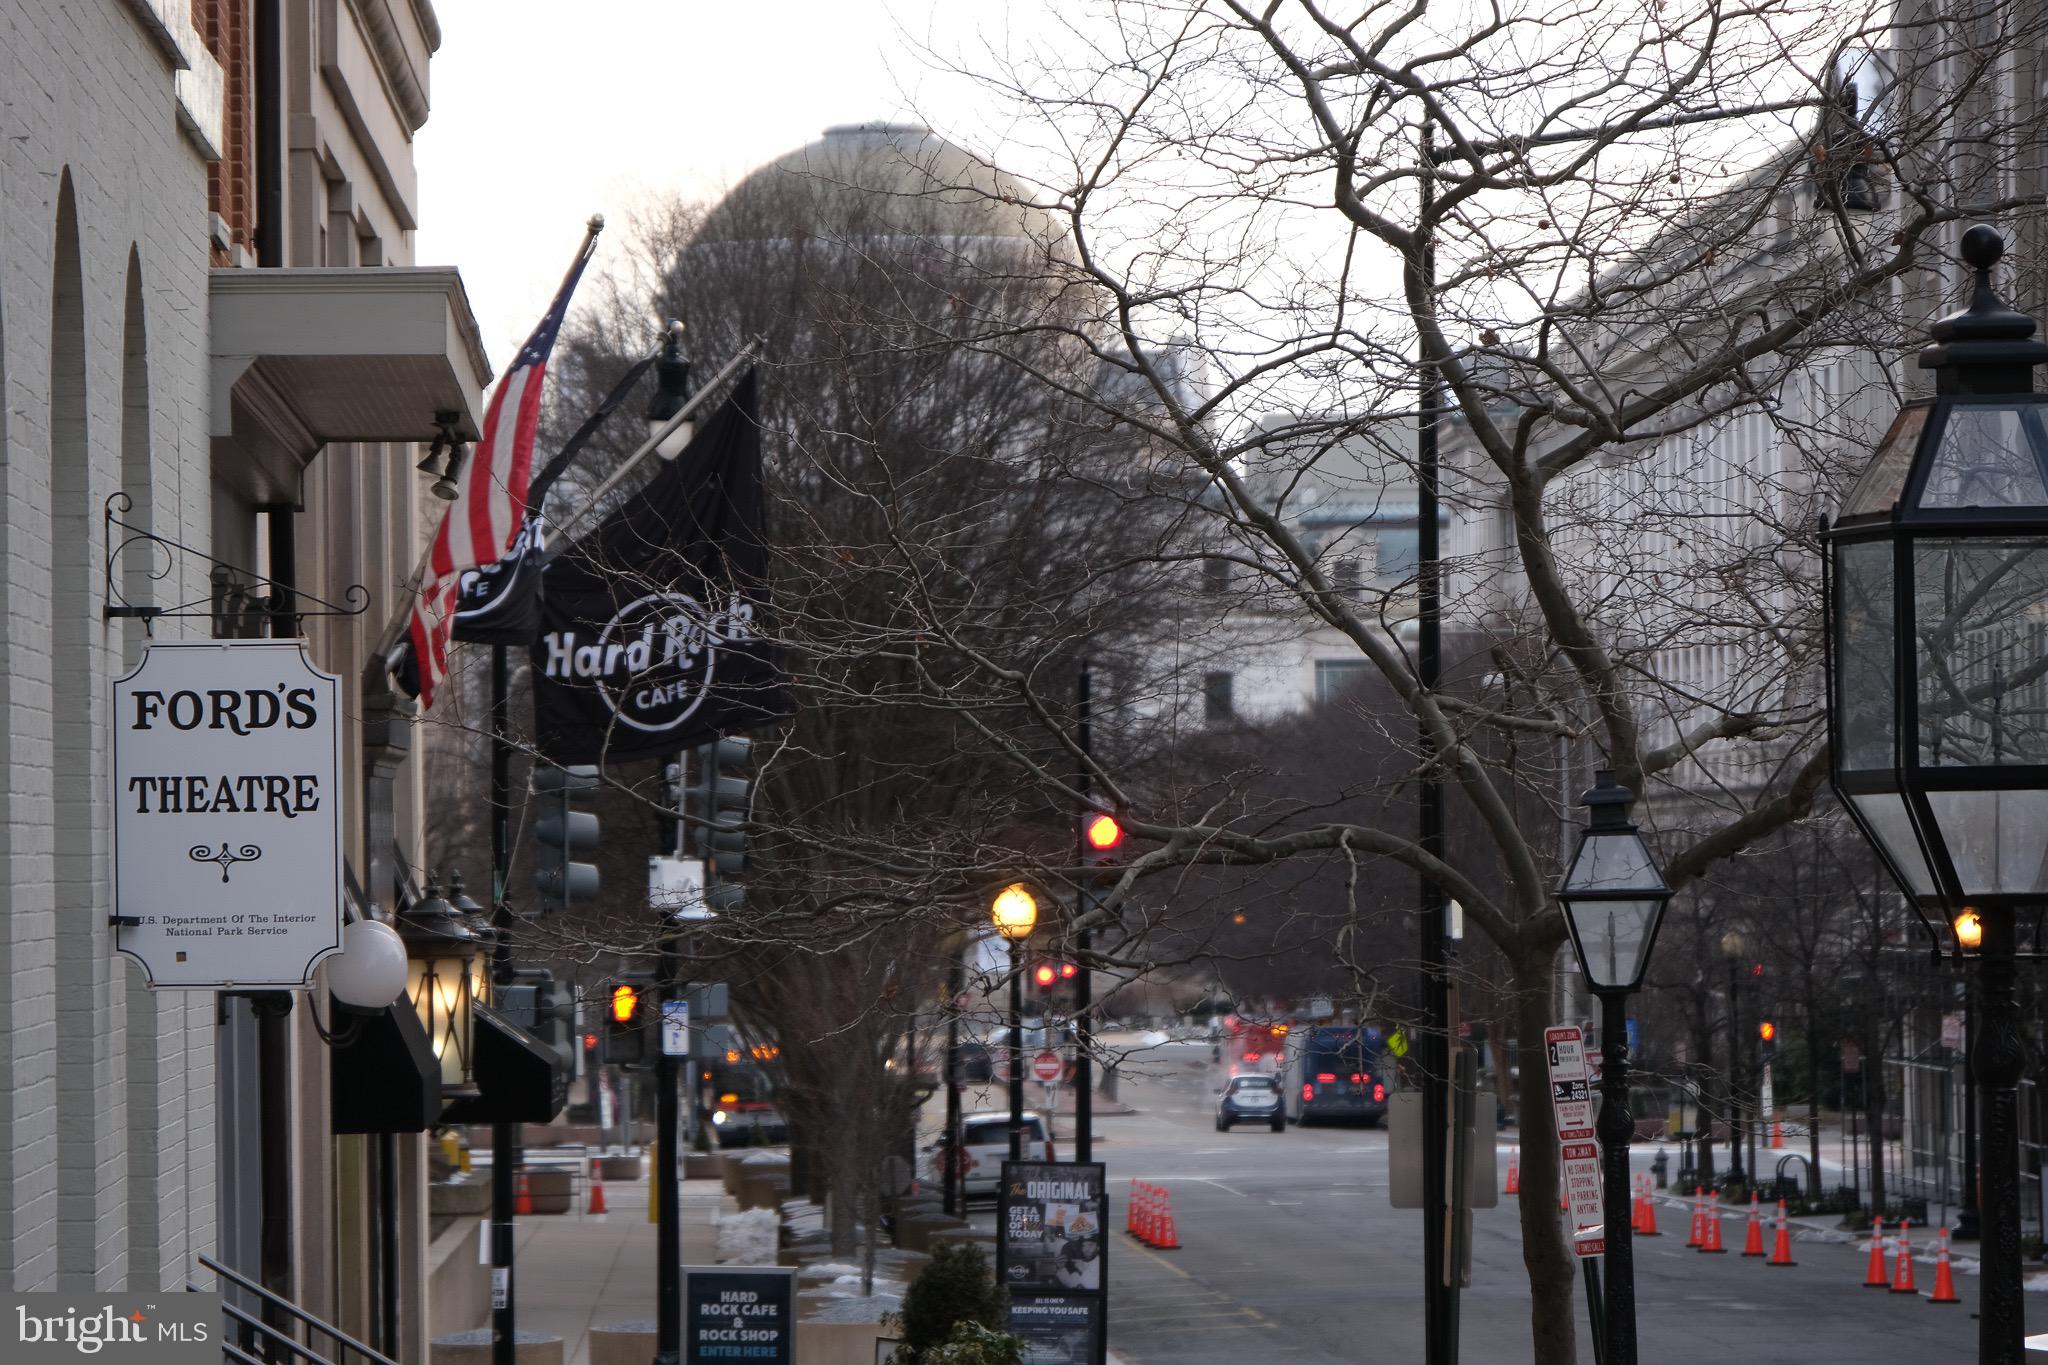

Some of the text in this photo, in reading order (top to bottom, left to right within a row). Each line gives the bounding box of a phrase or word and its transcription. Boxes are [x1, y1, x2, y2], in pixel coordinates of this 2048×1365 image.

[543, 622, 655, 678] Hard
[635, 679, 688, 710] CAFE
[131, 682, 318, 736] FORD'S
[128, 774, 320, 819] THEATRE
[162, 915, 228, 927] Department
[231, 914, 245, 924] Of
[249, 914, 269, 924] The
[273, 914, 317, 923] Interior
[165, 926, 288, 937] National Park Service
[1551, 1046, 1557, 1063] 2
[1559, 1045, 1575, 1054] HOUR
[1027, 1181, 1091, 1200] ORIGINAL
[1577, 1189, 1599, 1202] PARKING
[1009, 1206, 1038, 1215] GET A
[1576, 1202, 1599, 1215] ANYTIME
[1009, 1222, 1023, 1231] OF
[1009, 1230, 1044, 1239] TODAY
[720, 1291, 758, 1303] HARD
[700, 1304, 778, 1316] ROCK CAFE
[1011, 1306, 1089, 1315] KEEPING YOU SAFE
[733, 1317, 743, 1328] &
[699, 1329, 779, 1342] ROCK SHOP
[700, 1346, 778, 1358] ENTER HERE
